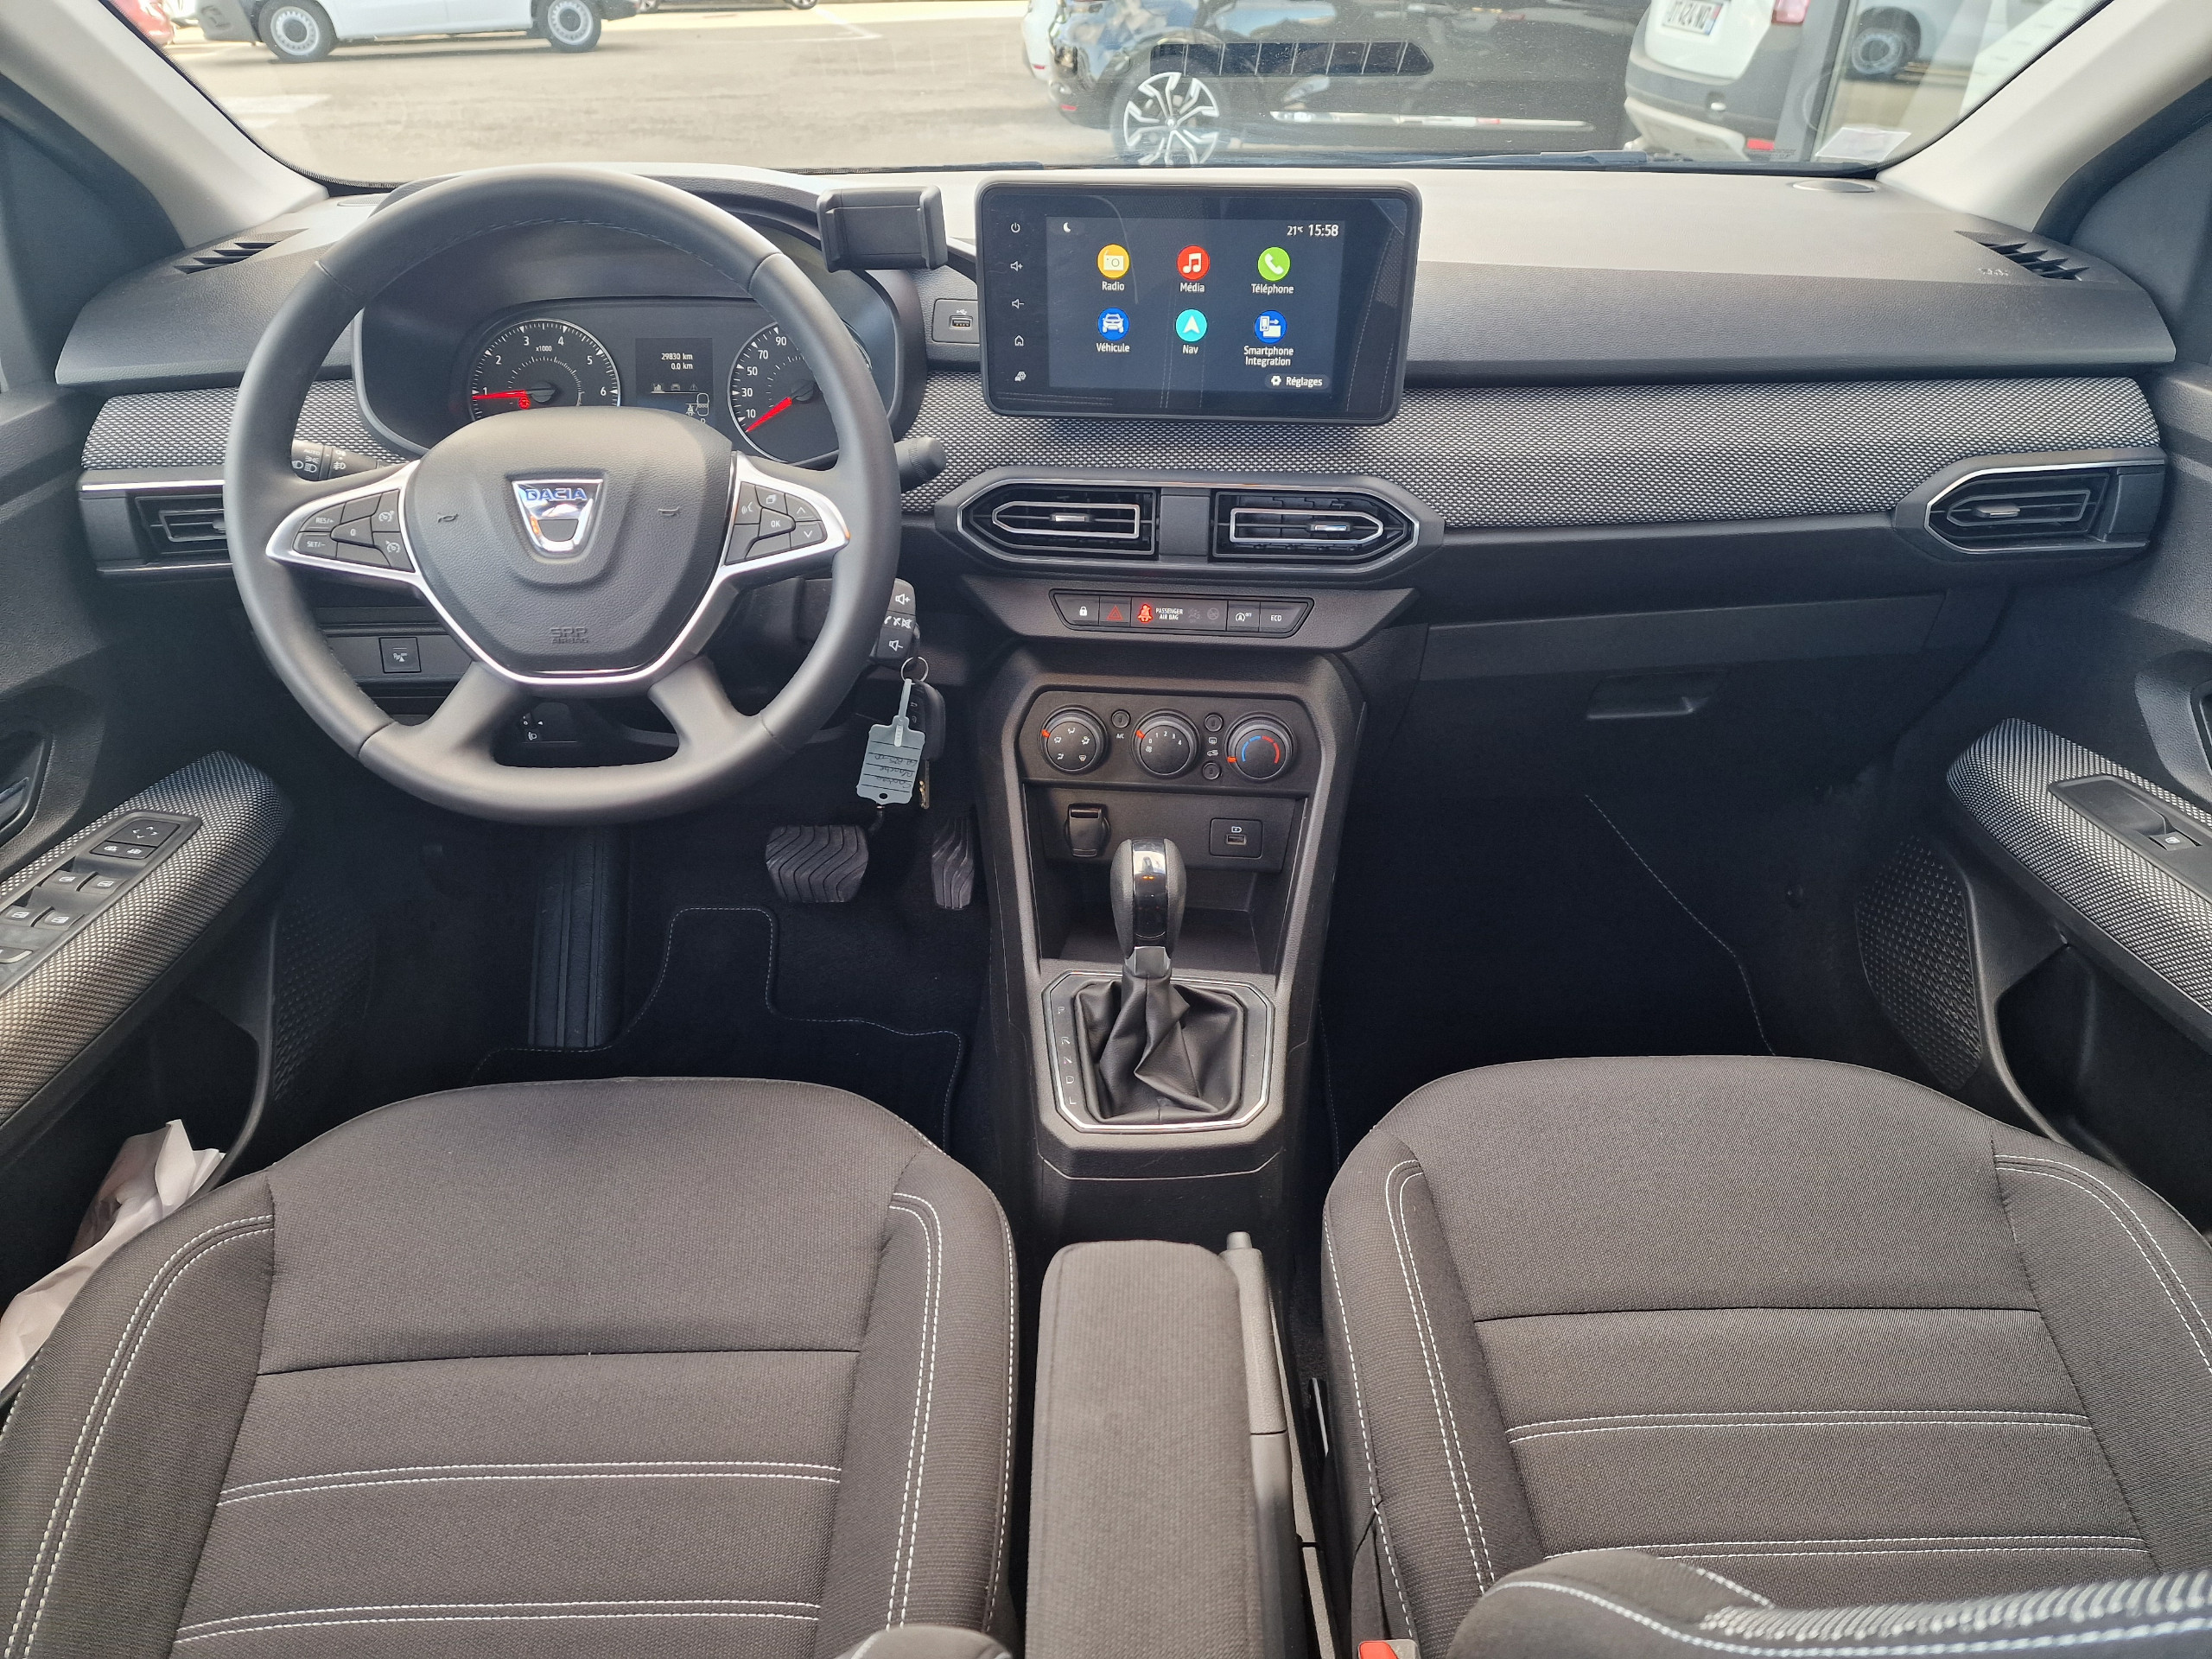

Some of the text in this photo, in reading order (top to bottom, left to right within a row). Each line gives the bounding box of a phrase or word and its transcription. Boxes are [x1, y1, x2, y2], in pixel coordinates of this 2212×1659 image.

[1308, 224, 1339, 237] 15:58
[1102, 281, 1125, 291] Radio
[1179, 282, 1205, 292] Média
[1250, 283, 1294, 296] Téléphone
[523, 335, 530, 346] 3
[557, 335, 564, 346] 4
[775, 336, 787, 346] 90
[1096, 342, 1130, 353] Véhicule
[1182, 345, 1199, 355] Nav
[1243, 346, 1294, 358] Smartphone
[757, 349, 769, 359] 70
[495, 355, 502, 365] 2
[587, 355, 593, 365] 5
[1245, 356, 1292, 368] Integration
[747, 366, 759, 376] 50
[1286, 376, 1324, 388] Réglages
[483, 386, 488, 396] 1
[600, 386, 607, 397] 6
[741, 387, 753, 397] 30
[746, 408, 756, 418] 10
[525, 488, 588, 501] DACIA
[770, 519, 781, 528] OK
[1058, 1006, 1065, 1014] P
[1065, 1075, 1075, 1084] D
[1069, 1096, 1077, 1105] L
